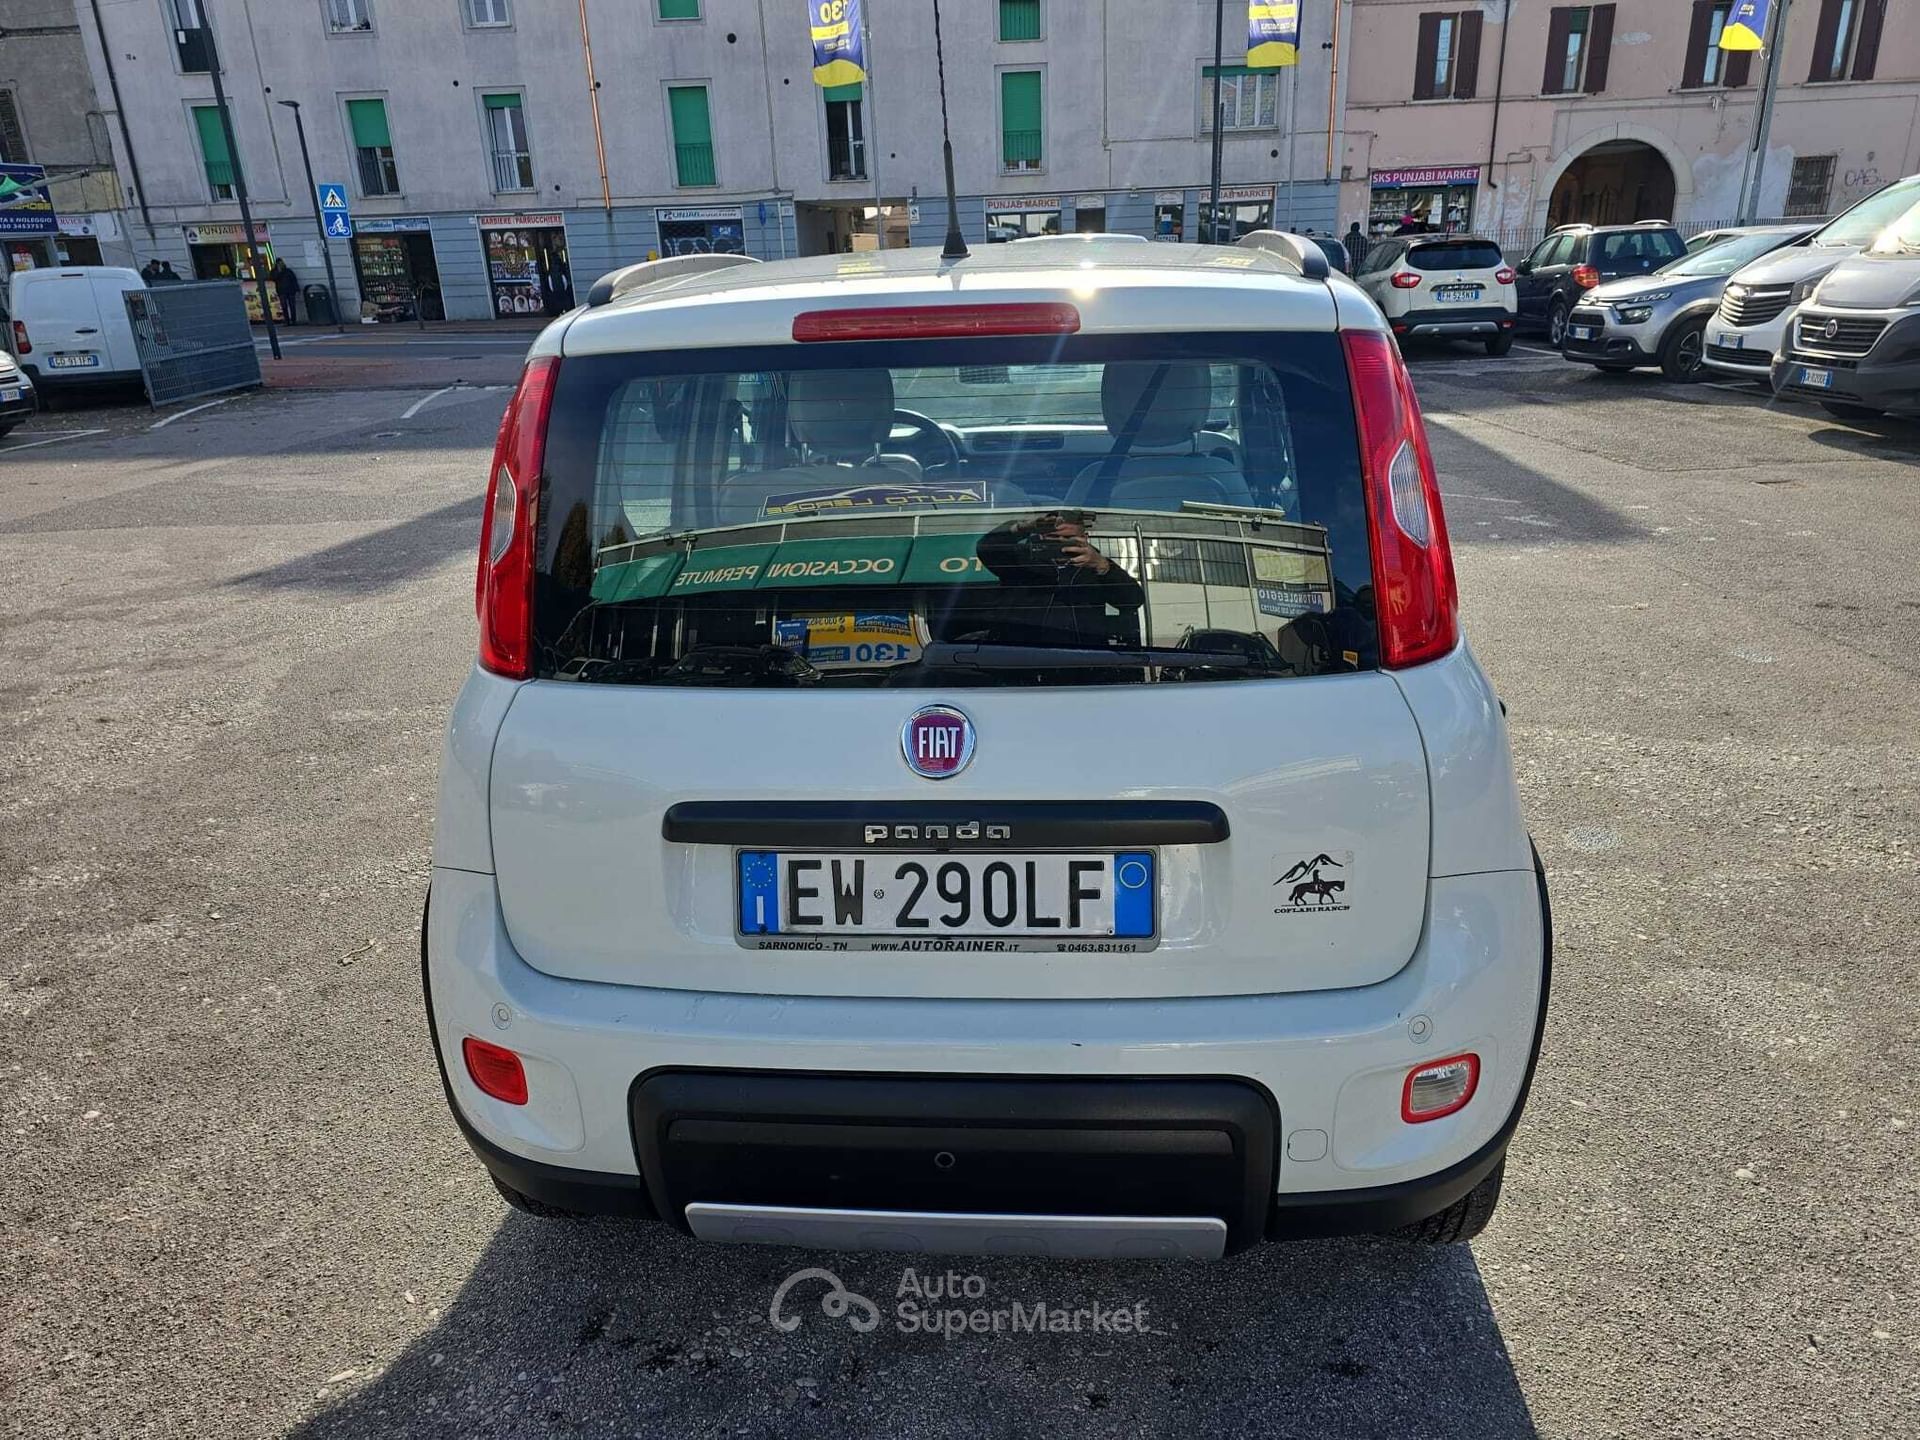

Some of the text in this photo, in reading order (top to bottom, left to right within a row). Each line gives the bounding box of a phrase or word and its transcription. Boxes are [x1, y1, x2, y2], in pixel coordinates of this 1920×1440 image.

[1372, 169, 1479, 183] SKS PUNJABI MARKET
[1200, 188, 1273, 200] PUJAB MARKET
[987, 198, 1060, 209] PUNJAB MARKET
[918, 726, 961, 759] FIAT
[864, 820, 1011, 844] panda
[788, 859, 865, 926] EW
[895, 861, 1105, 929] 290LF
[1317, 905, 1351, 913] RANCH
[758, 941, 824, 951] SARNONICO
[833, 942, 848, 951] TN
[871, 940, 1020, 952] www.AUTORAINER.IT
[1067, 943, 1137, 953] 0463.831161
